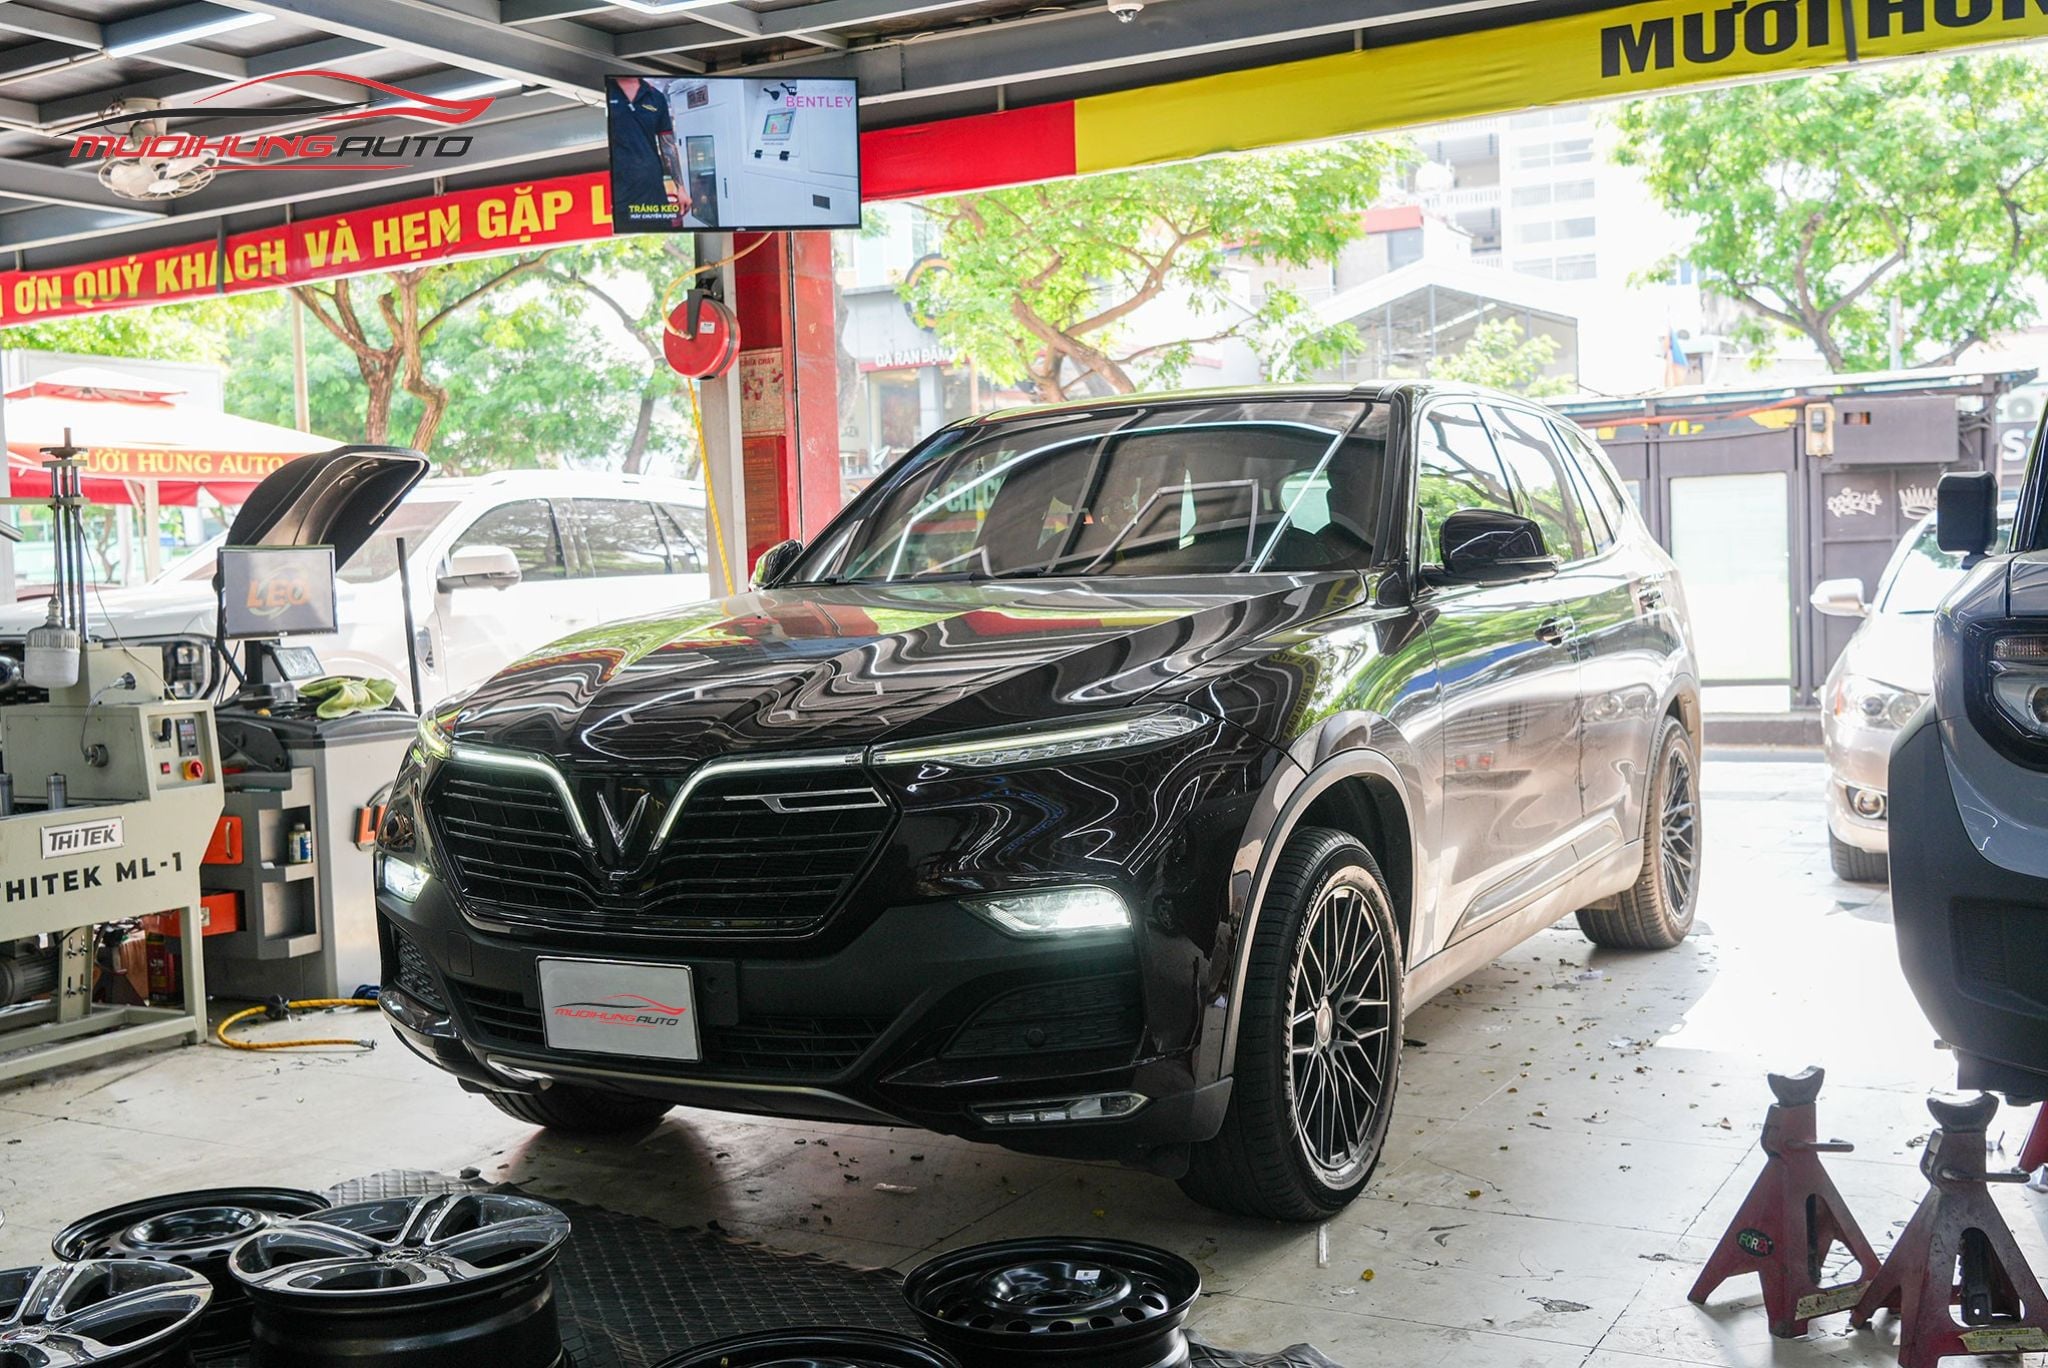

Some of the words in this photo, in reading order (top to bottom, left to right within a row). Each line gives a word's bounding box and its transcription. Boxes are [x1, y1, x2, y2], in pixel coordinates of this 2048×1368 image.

[786, 96, 853, 108] BENTLEY
[74, 256, 144, 308] QUÝ
[304, 219, 360, 269] VÀ
[372, 205, 461, 260] HẸN
[477, 185, 573, 244] GẶP
[137, 449, 212, 474] HÙNG
[220, 453, 284, 475] AUTO
[247, 579, 311, 609] LEO
[0, 865, 102, 903] HITEK
[116, 852, 182, 882] ML-1
